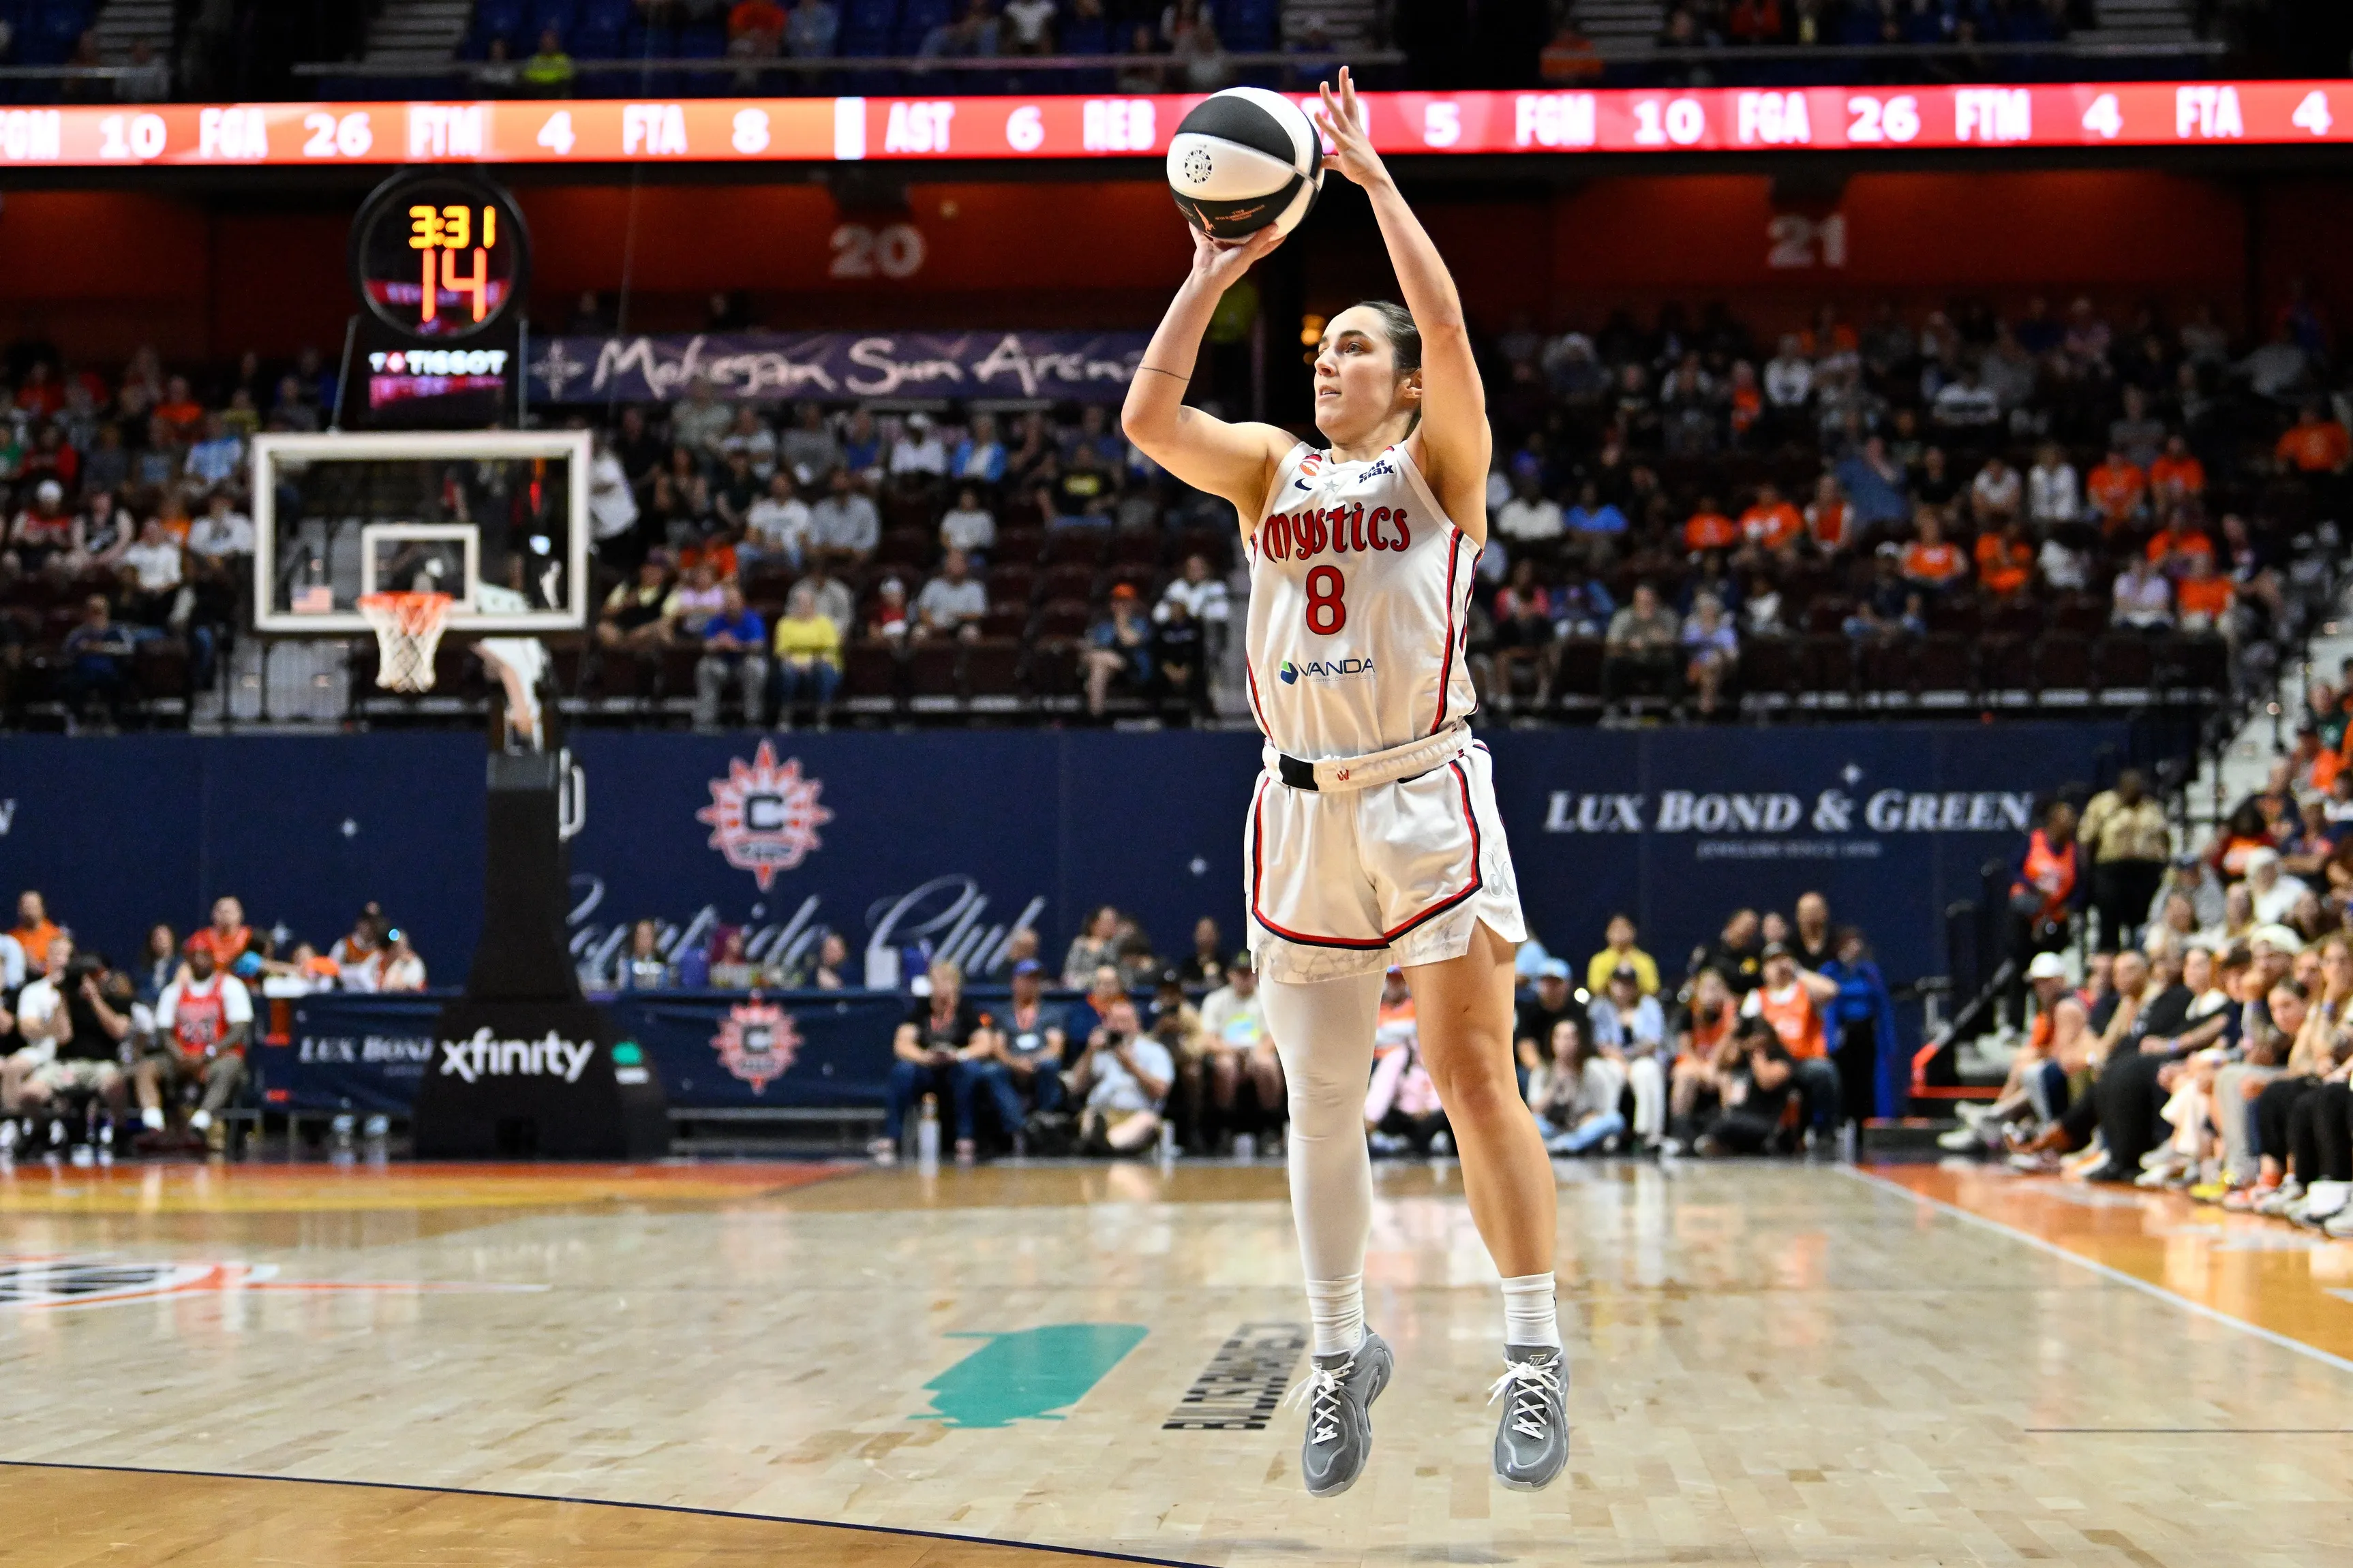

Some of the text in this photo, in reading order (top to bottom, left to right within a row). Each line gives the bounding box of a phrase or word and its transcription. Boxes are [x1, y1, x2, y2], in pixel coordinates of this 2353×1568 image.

[100, 114, 166, 158] 10
[200, 108, 267, 157] FGA
[304, 112, 371, 157] 26
[410, 106, 484, 156] FTM
[537, 111, 574, 154] 4
[623, 105, 686, 154] FTA
[731, 108, 770, 153] 8
[885, 103, 953, 153] AST
[1007, 108, 1044, 151] 6
[1084, 101, 1155, 150] REB
[1425, 102, 1460, 147] 5
[1516, 95, 1594, 146] FGM
[1635, 100, 1705, 144] 10
[1739, 93, 1810, 144] FGA
[1847, 97, 1919, 142] 26
[1956, 89, 2031, 140] FTM
[2083, 94, 2122, 138] 4
[2176, 87, 2242, 138] FTA
[2292, 91, 2331, 135] 4
[409, 206, 496, 249] 3:31
[830, 226, 924, 279] 20
[1767, 215, 1847, 268] 21
[421, 247, 487, 322] 14
[405, 349, 509, 375] TISSOT
[590, 335, 838, 400] Mohegan
[845, 337, 964, 395] Sun
[1359, 465, 1395, 484] max
[1262, 501, 1410, 564] mystics
[1305, 565, 1346, 636] 8
[1298, 658, 1376, 677] VANDA
[744, 793, 785, 831] C
[1544, 789, 2034, 833] LUX BOND & GREEN
[299, 1035, 354, 1064] LUX
[440, 1026, 596, 1085] xfinity
